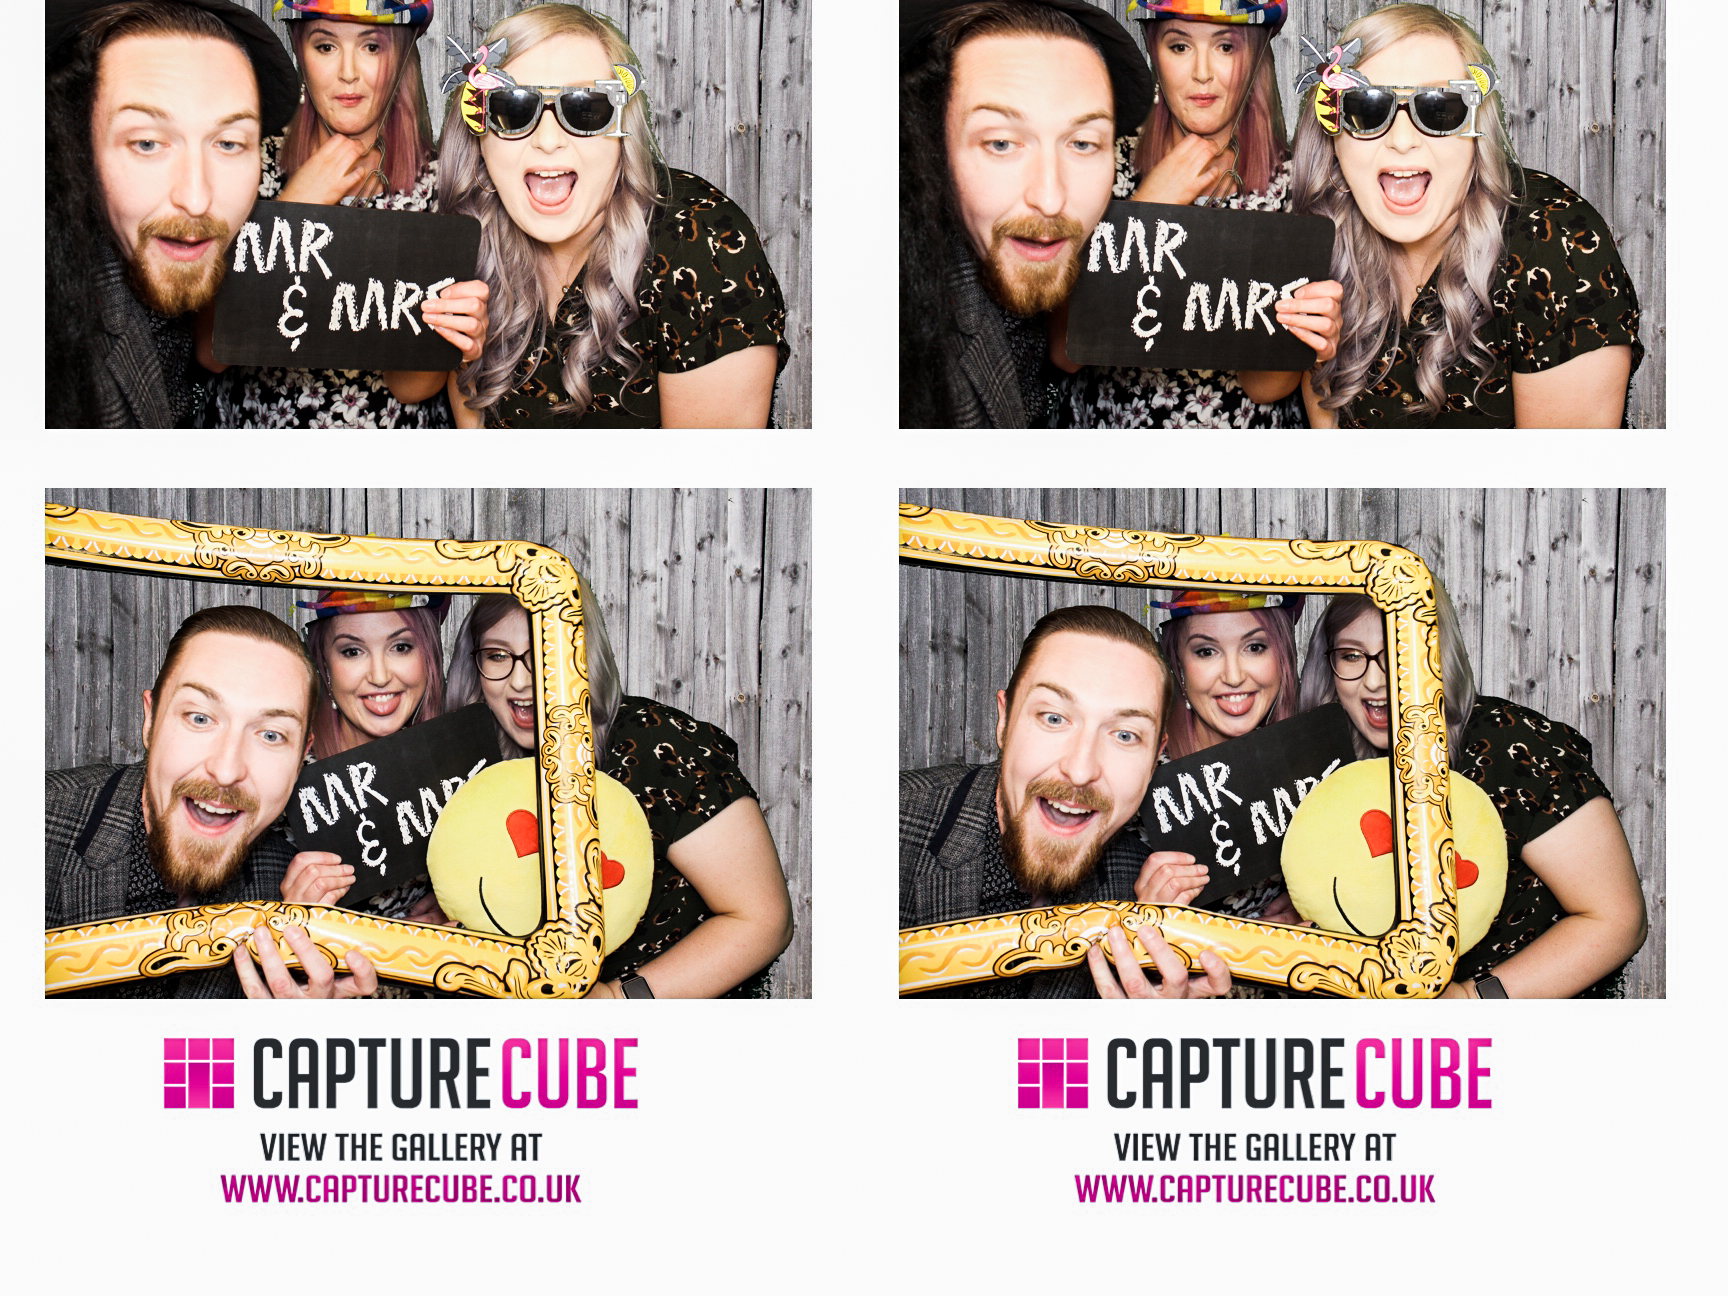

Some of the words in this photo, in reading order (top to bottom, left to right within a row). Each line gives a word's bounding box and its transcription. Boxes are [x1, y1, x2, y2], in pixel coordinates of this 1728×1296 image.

[233, 216, 334, 280] MR
[1087, 216, 1188, 280] MR
[277, 275, 309, 352] &
[1131, 275, 1163, 352] &
[298, 761, 389, 834] MR
[1152, 761, 1243, 834] MR
[356, 813, 388, 876] &
[1210, 813, 1242, 876] &
